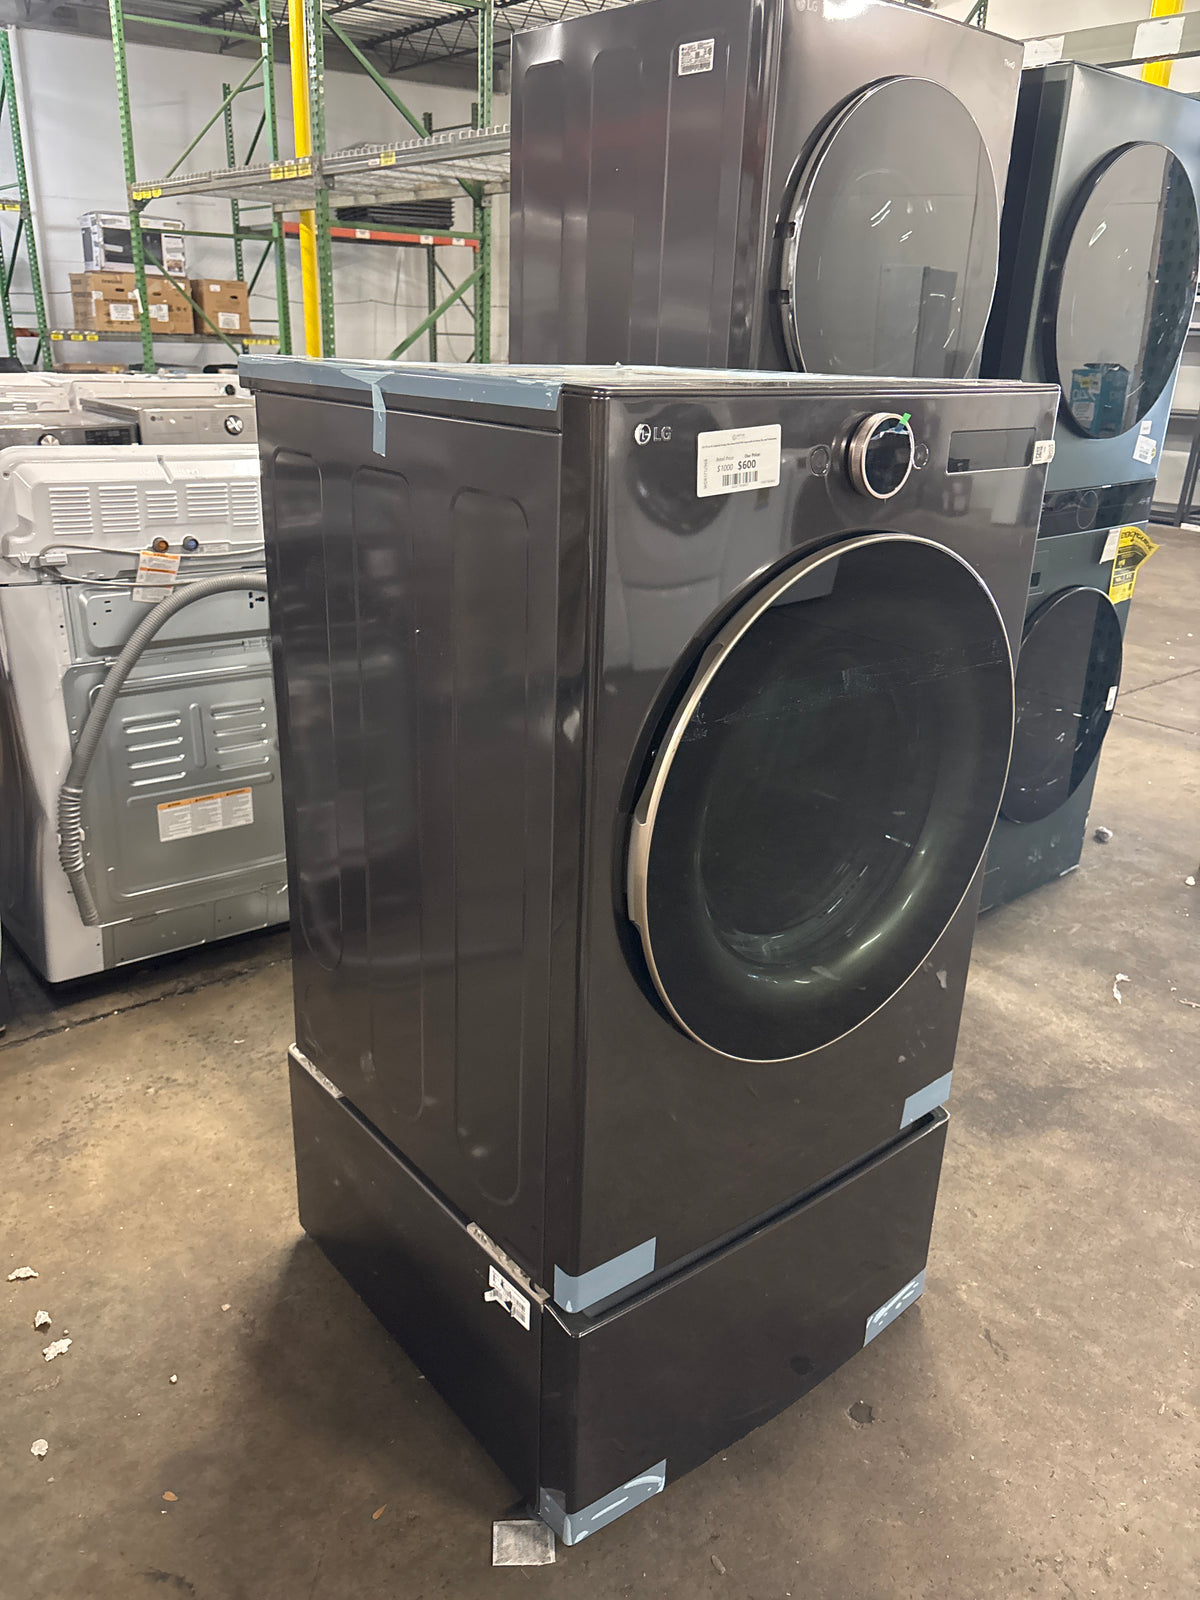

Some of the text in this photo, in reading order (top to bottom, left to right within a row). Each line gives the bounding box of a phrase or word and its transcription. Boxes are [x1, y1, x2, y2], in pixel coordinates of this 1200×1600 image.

[653, 426, 672, 442] LG
[716, 463, 734, 473] $1000
[737, 459, 757, 471] $600
